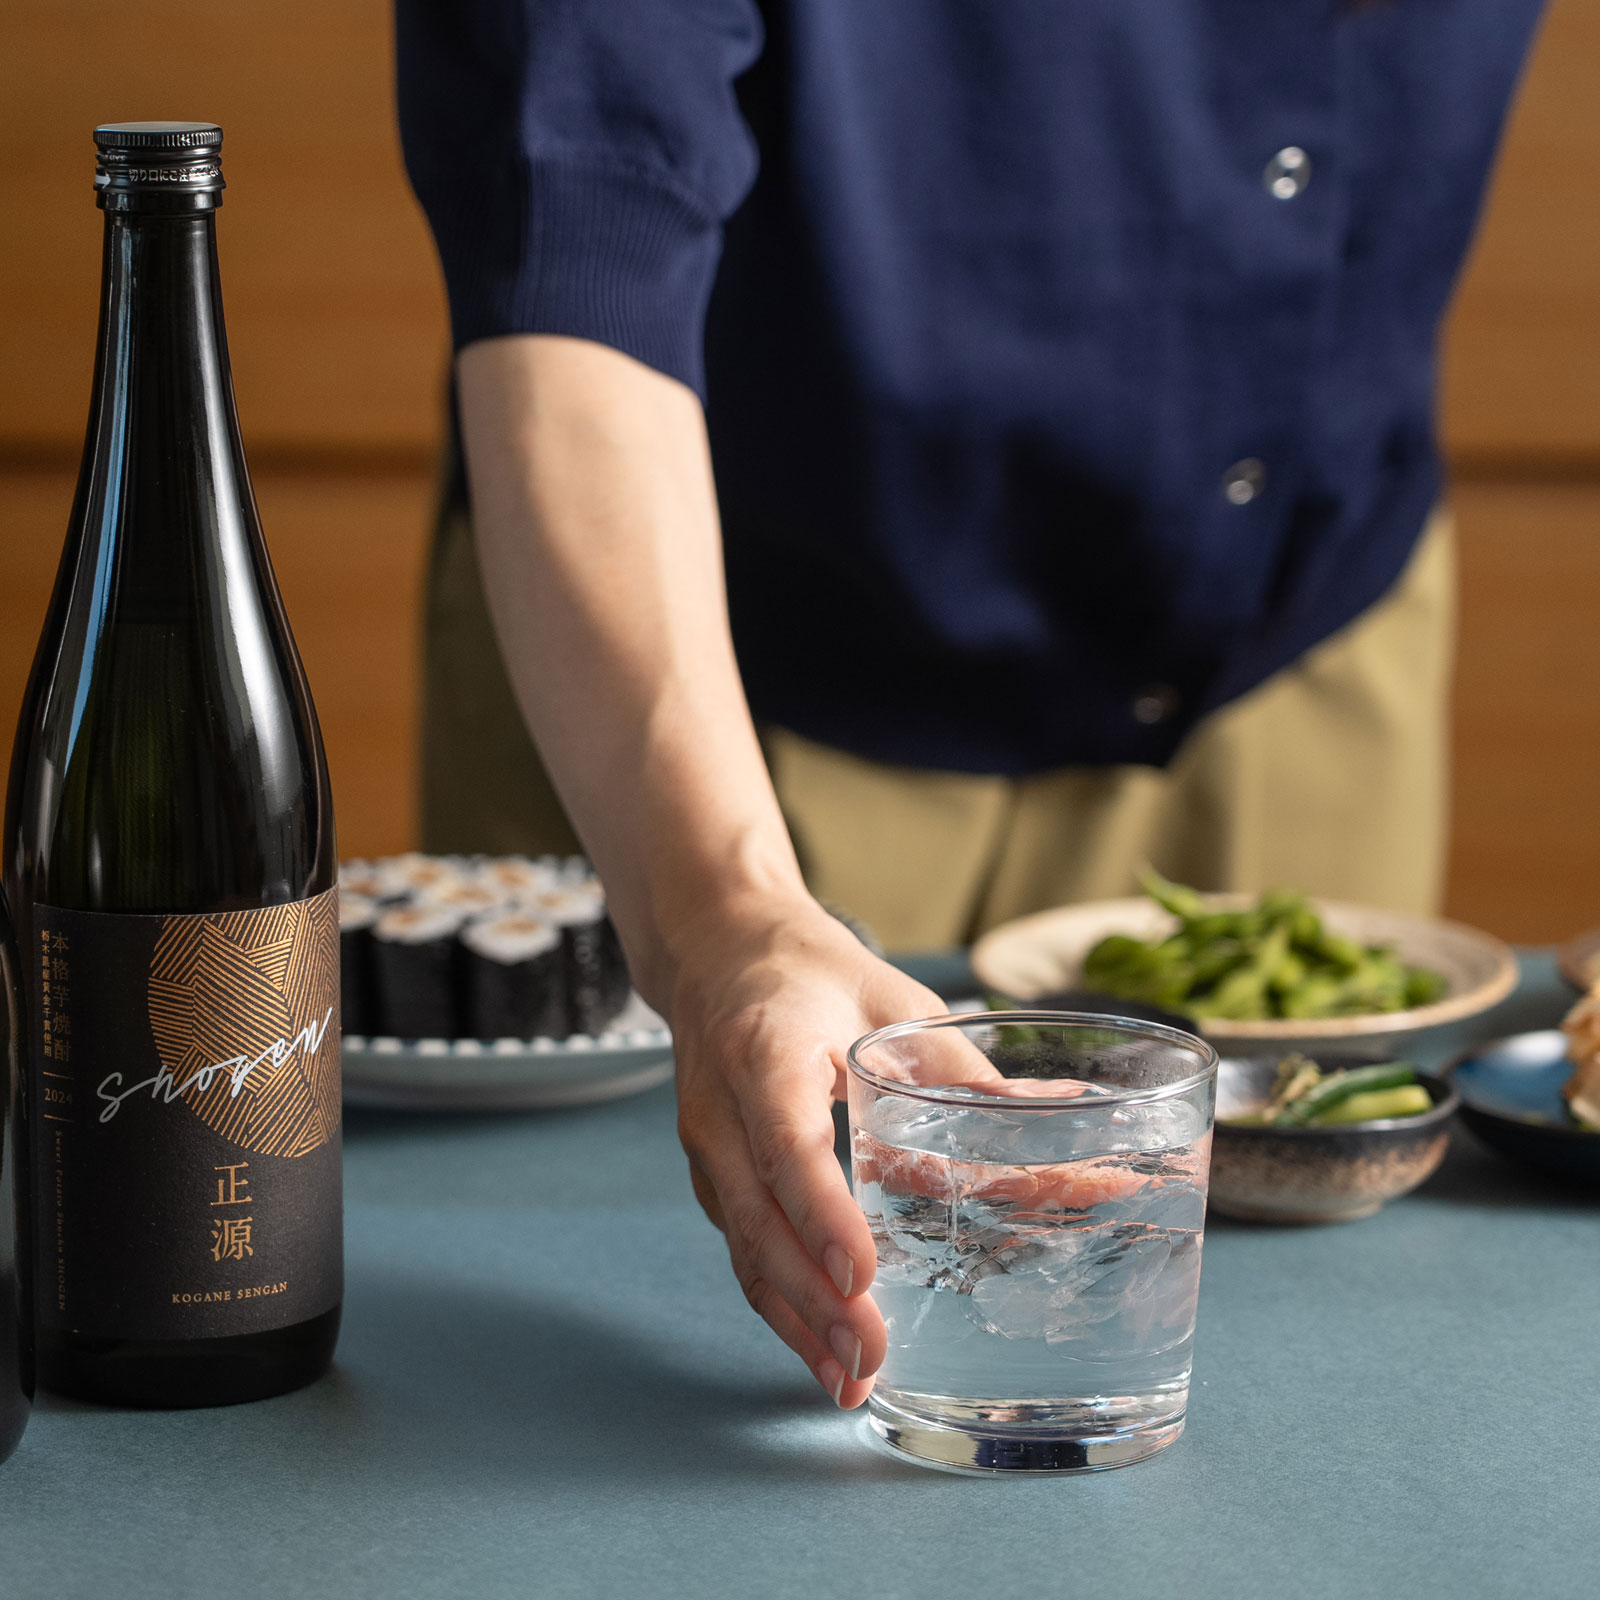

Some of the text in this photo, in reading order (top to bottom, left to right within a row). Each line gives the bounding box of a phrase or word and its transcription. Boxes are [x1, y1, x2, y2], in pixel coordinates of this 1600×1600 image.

[52, 931, 71, 1062] 本格芋焼酎
[44, 1087, 73, 1105] 2024
[210, 1161, 254, 1262] 正源
[57, 1257, 66, 1311] SHOGEN
[172, 1281, 288, 1304] KOGANE SENGAN
